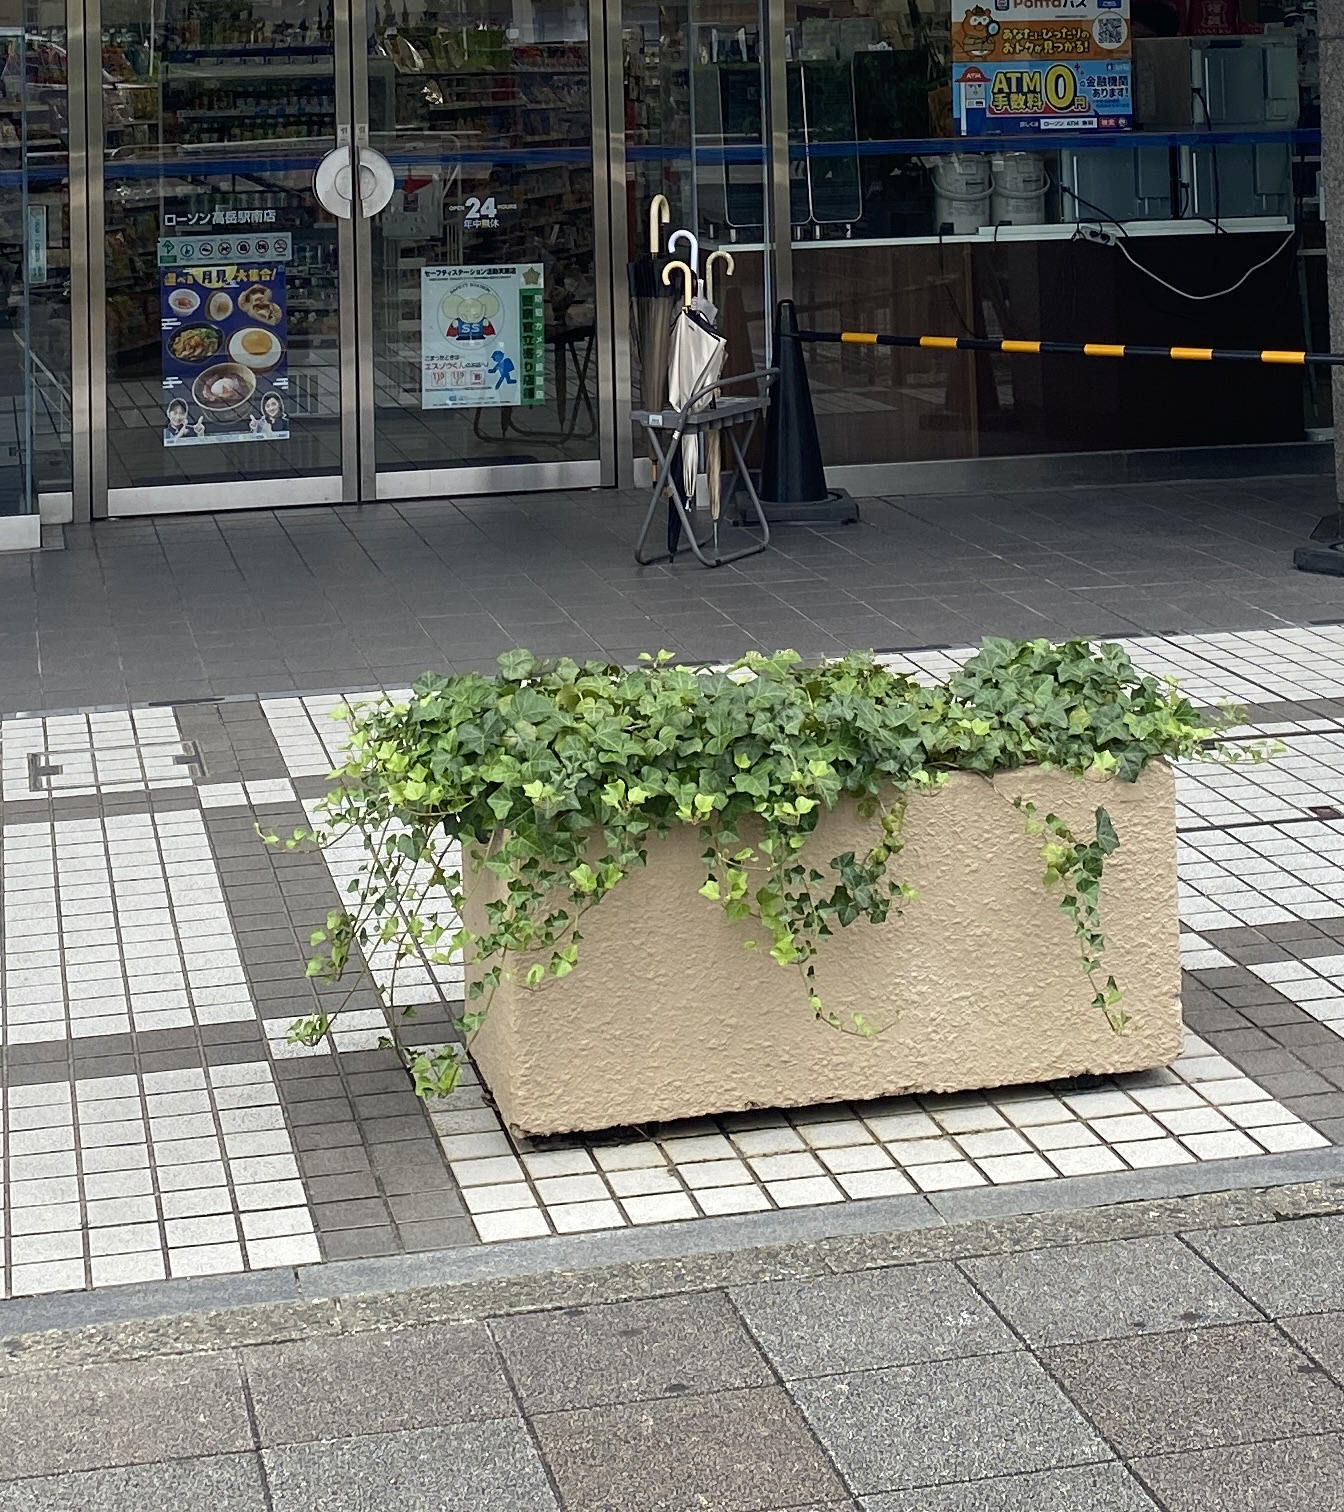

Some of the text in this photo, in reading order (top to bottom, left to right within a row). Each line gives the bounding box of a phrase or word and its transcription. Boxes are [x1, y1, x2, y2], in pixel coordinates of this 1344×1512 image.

[1002, 27, 1090, 40] あなたにぴったりの
[992, 70, 1042, 94] ATM
[1091, 88, 1129, 99] あります!
[992, 93, 1044, 111] 手数料
[464, 196, 498, 219] 24
[461, 324, 480, 333] SS
